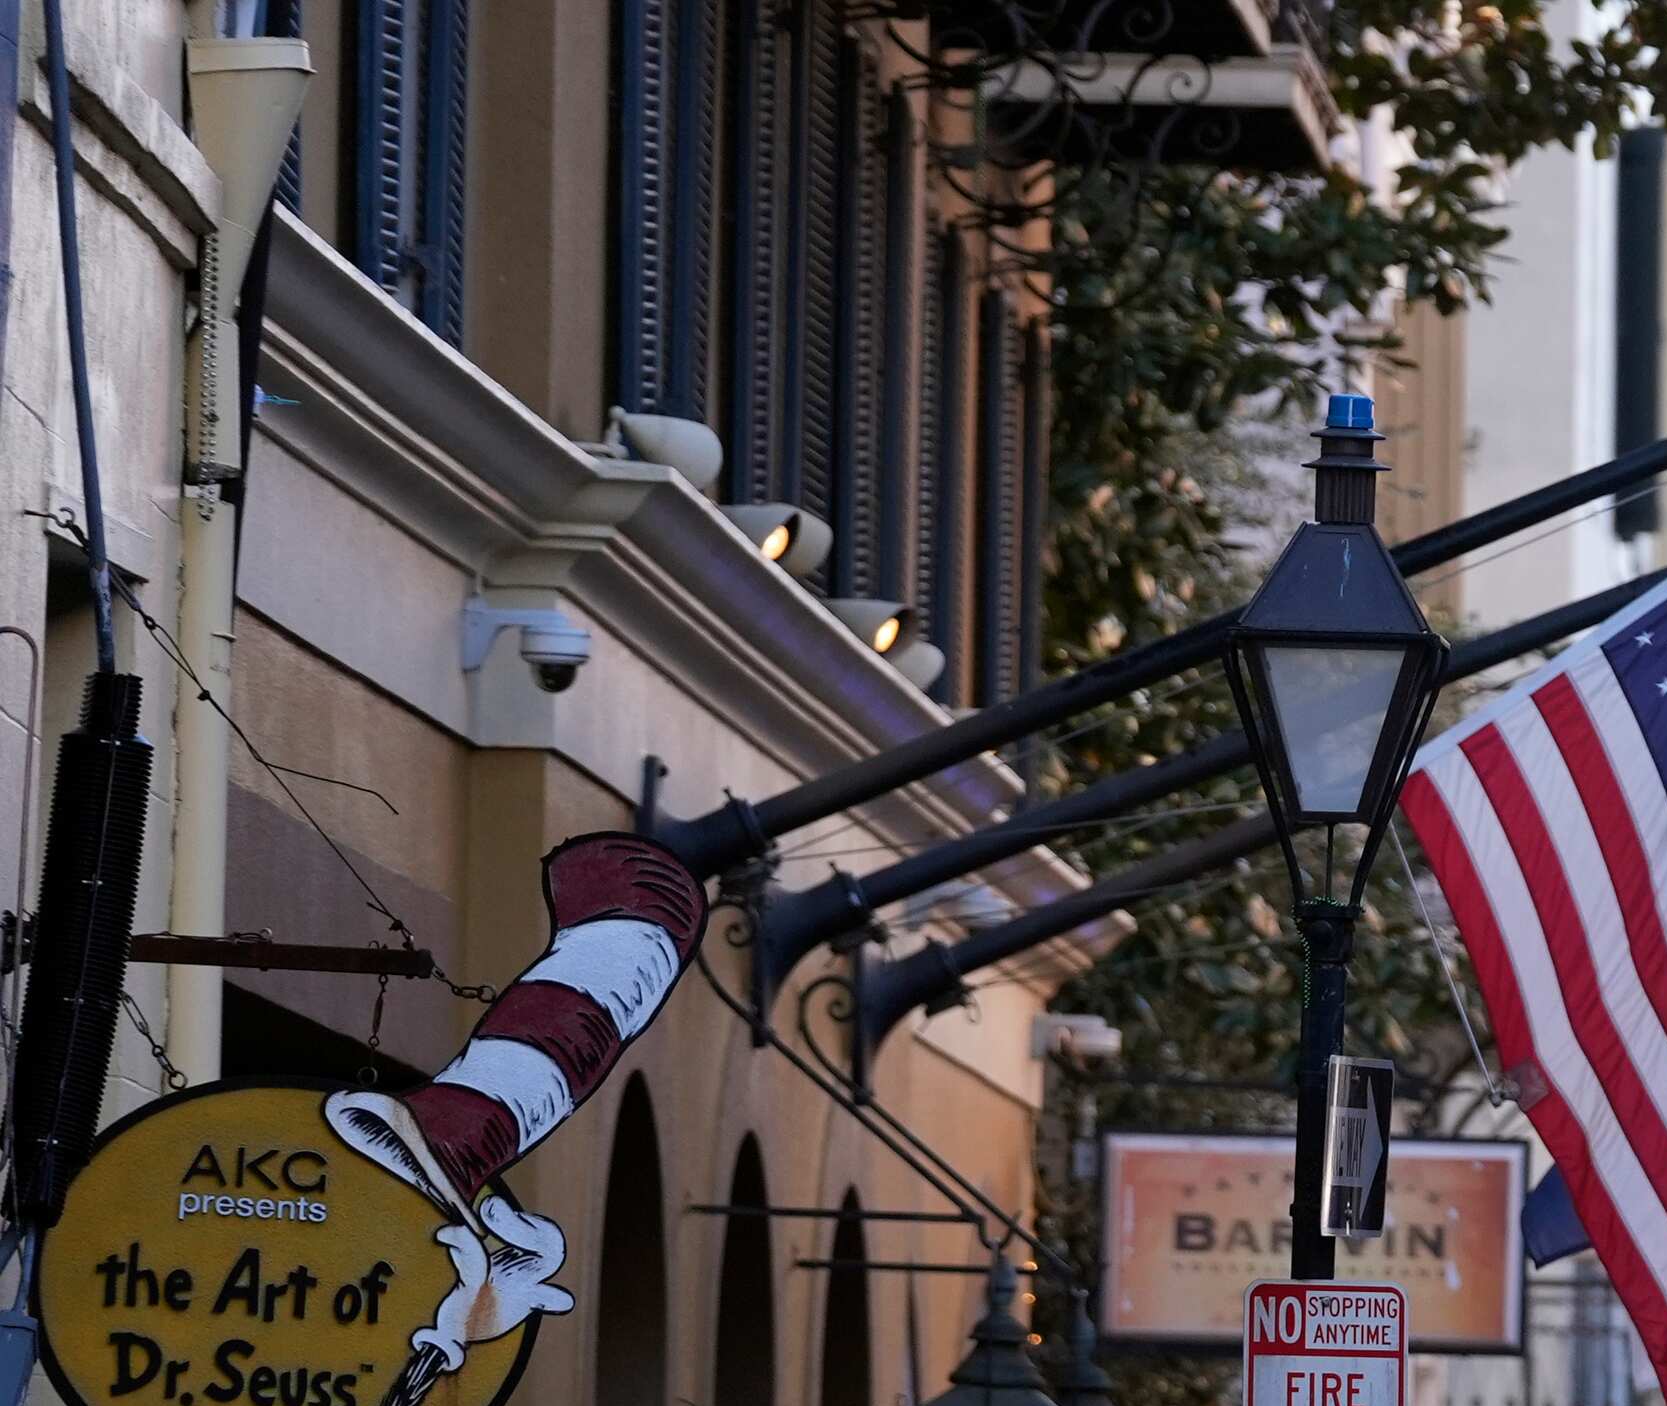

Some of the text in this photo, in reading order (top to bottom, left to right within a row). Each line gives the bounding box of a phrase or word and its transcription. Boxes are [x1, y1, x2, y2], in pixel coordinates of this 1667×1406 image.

[178, 1192, 328, 1223] presents
[96, 1242, 395, 1325] the Art of
[1253, 1295, 1398, 1344] NO STOPPING
[1313, 1324, 1392, 1346] ANYTIME
[108, 1332, 195, 1406] Dr.
